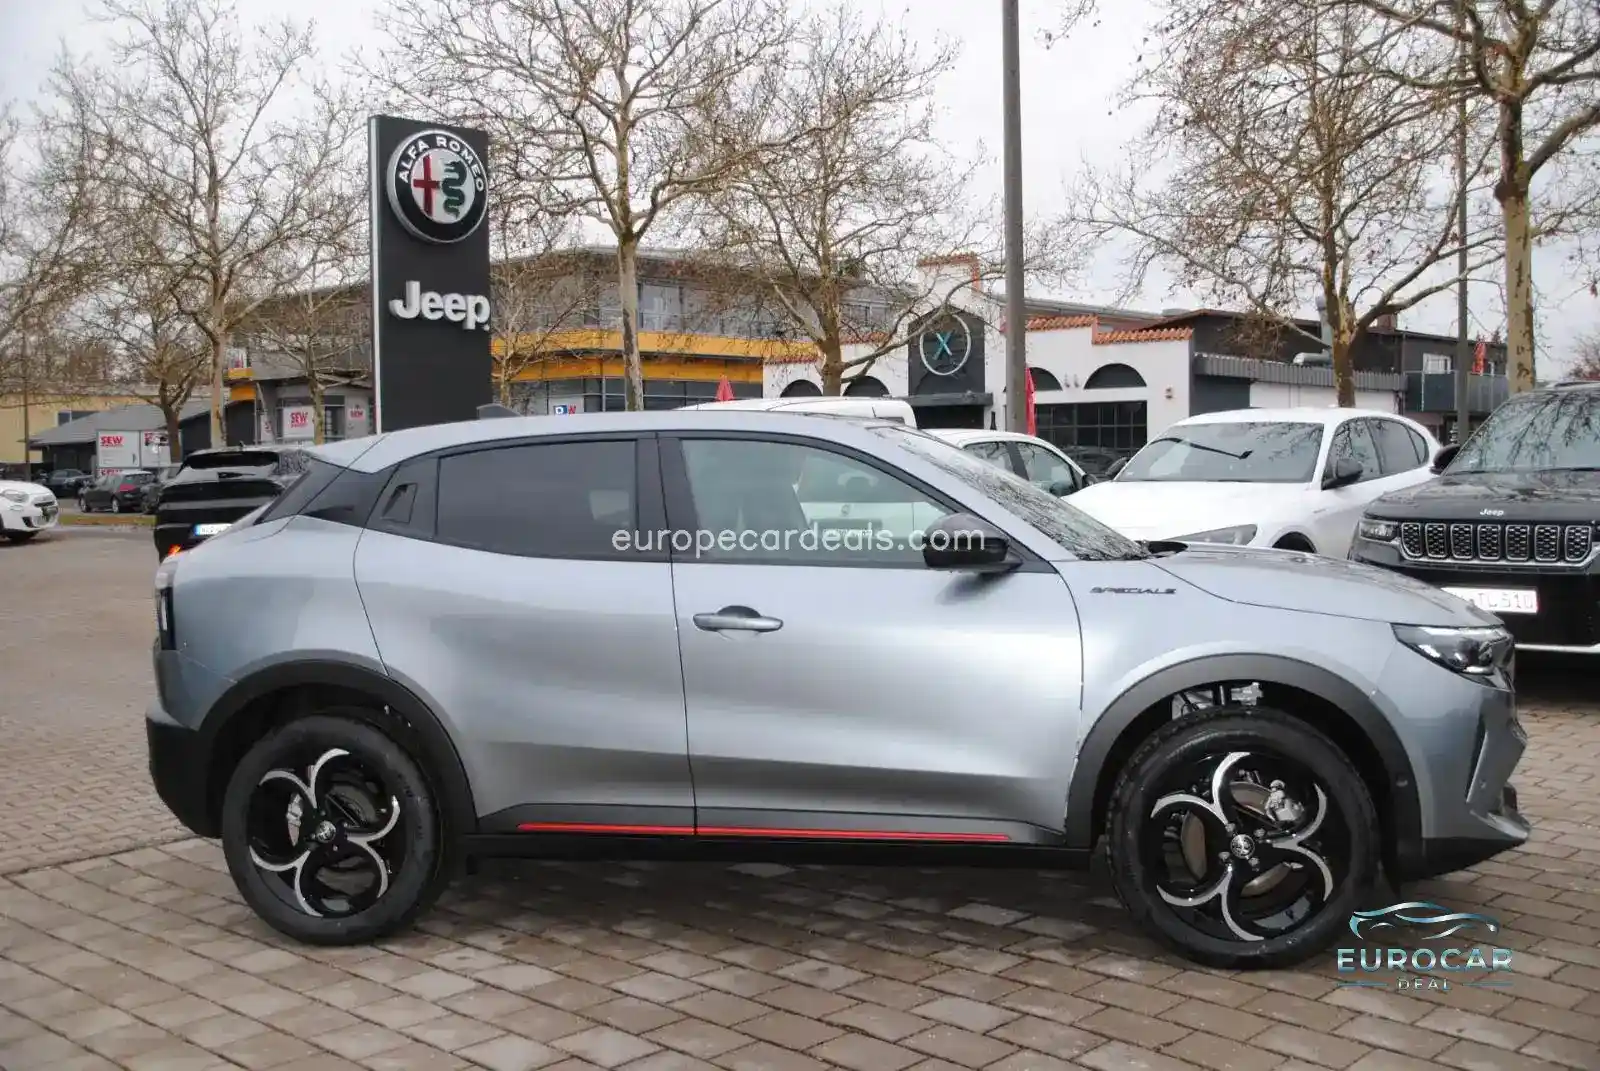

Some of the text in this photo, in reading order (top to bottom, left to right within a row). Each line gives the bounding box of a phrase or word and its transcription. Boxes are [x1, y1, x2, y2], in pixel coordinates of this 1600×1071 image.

[399, 136, 484, 192] ALFA ROMEO
[388, 280, 491, 330] Jeep
[290, 411, 309, 424] SEW
[100, 435, 124, 444] SEW
[1479, 508, 1505, 517] Jeep
